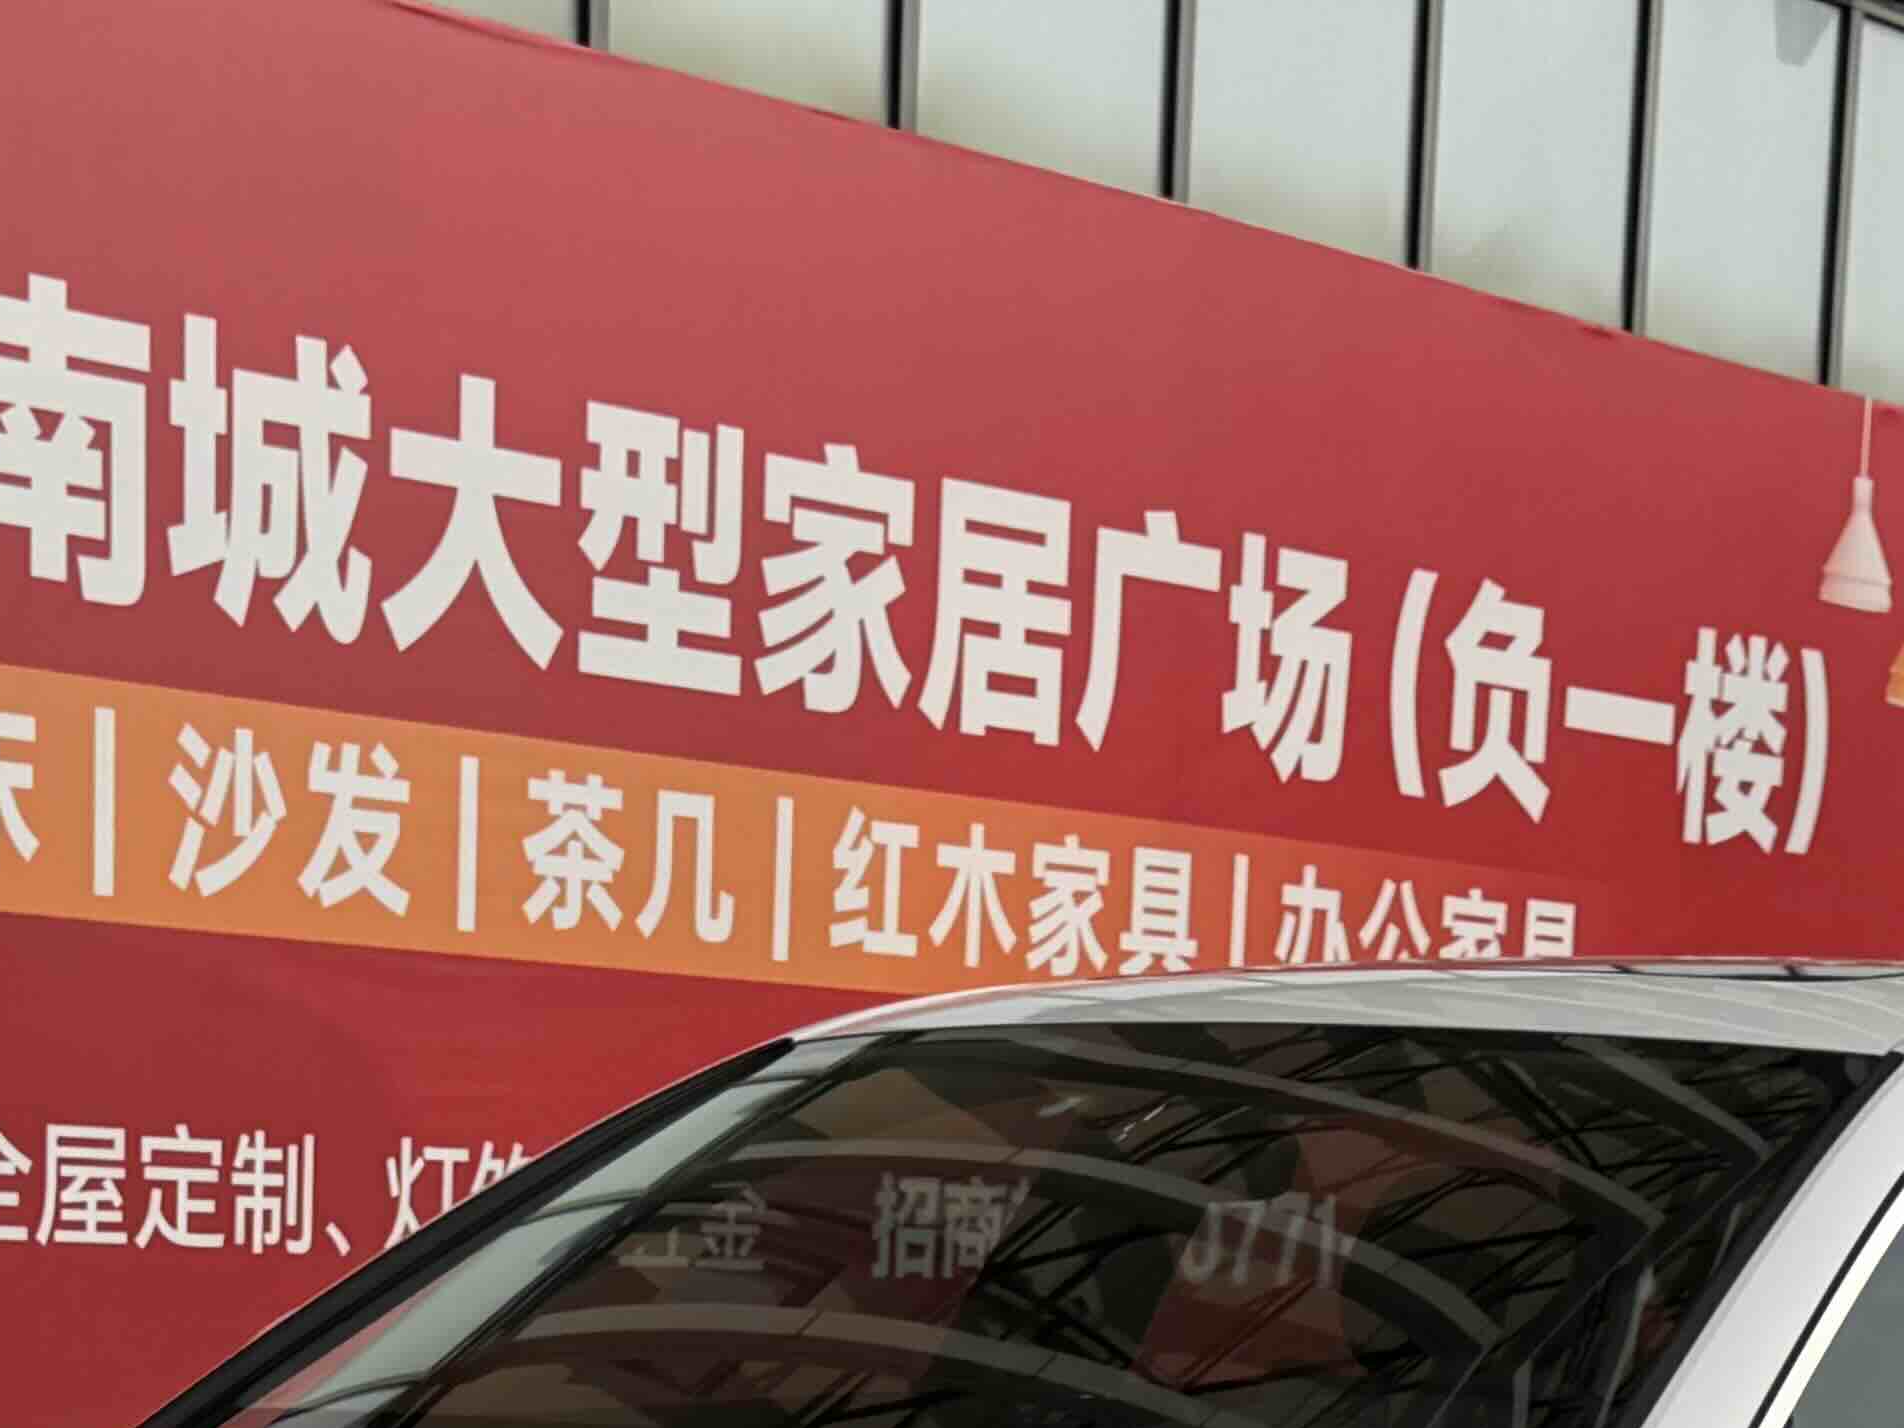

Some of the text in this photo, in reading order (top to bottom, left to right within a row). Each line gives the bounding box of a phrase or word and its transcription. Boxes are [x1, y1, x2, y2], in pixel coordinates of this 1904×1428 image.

[168, 722, 412, 917] 沙发
[521, 770, 736, 948] 茶几
[829, 802, 1199, 977] 红木家具
